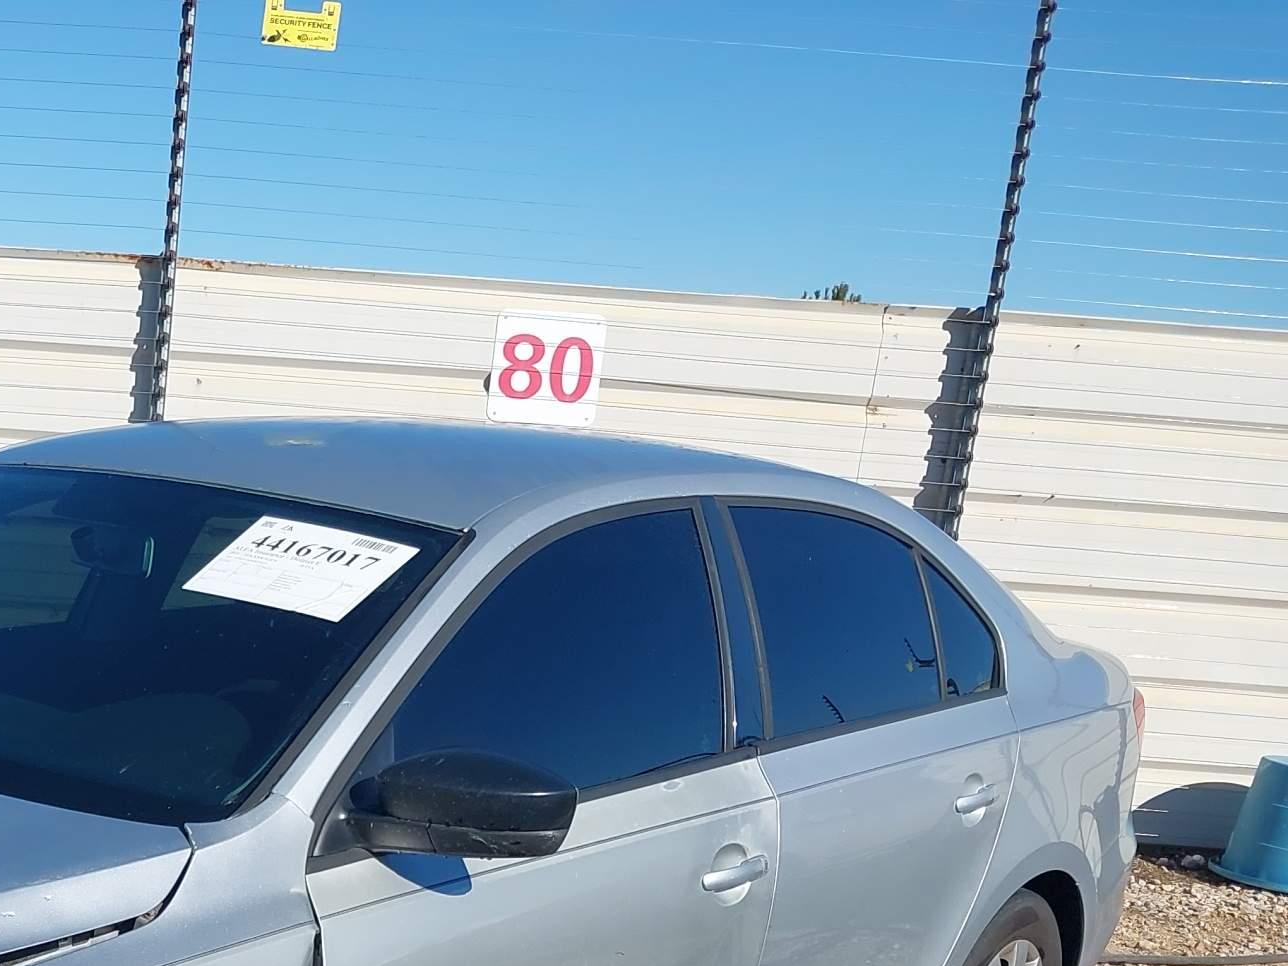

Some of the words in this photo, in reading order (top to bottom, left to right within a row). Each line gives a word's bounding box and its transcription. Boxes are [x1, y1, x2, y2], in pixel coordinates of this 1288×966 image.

[269, 17, 307, 27] SECURITY
[308, 21, 333, 30] FENCE
[498, 333, 594, 404] 80
[251, 535, 382, 570] 44167017
